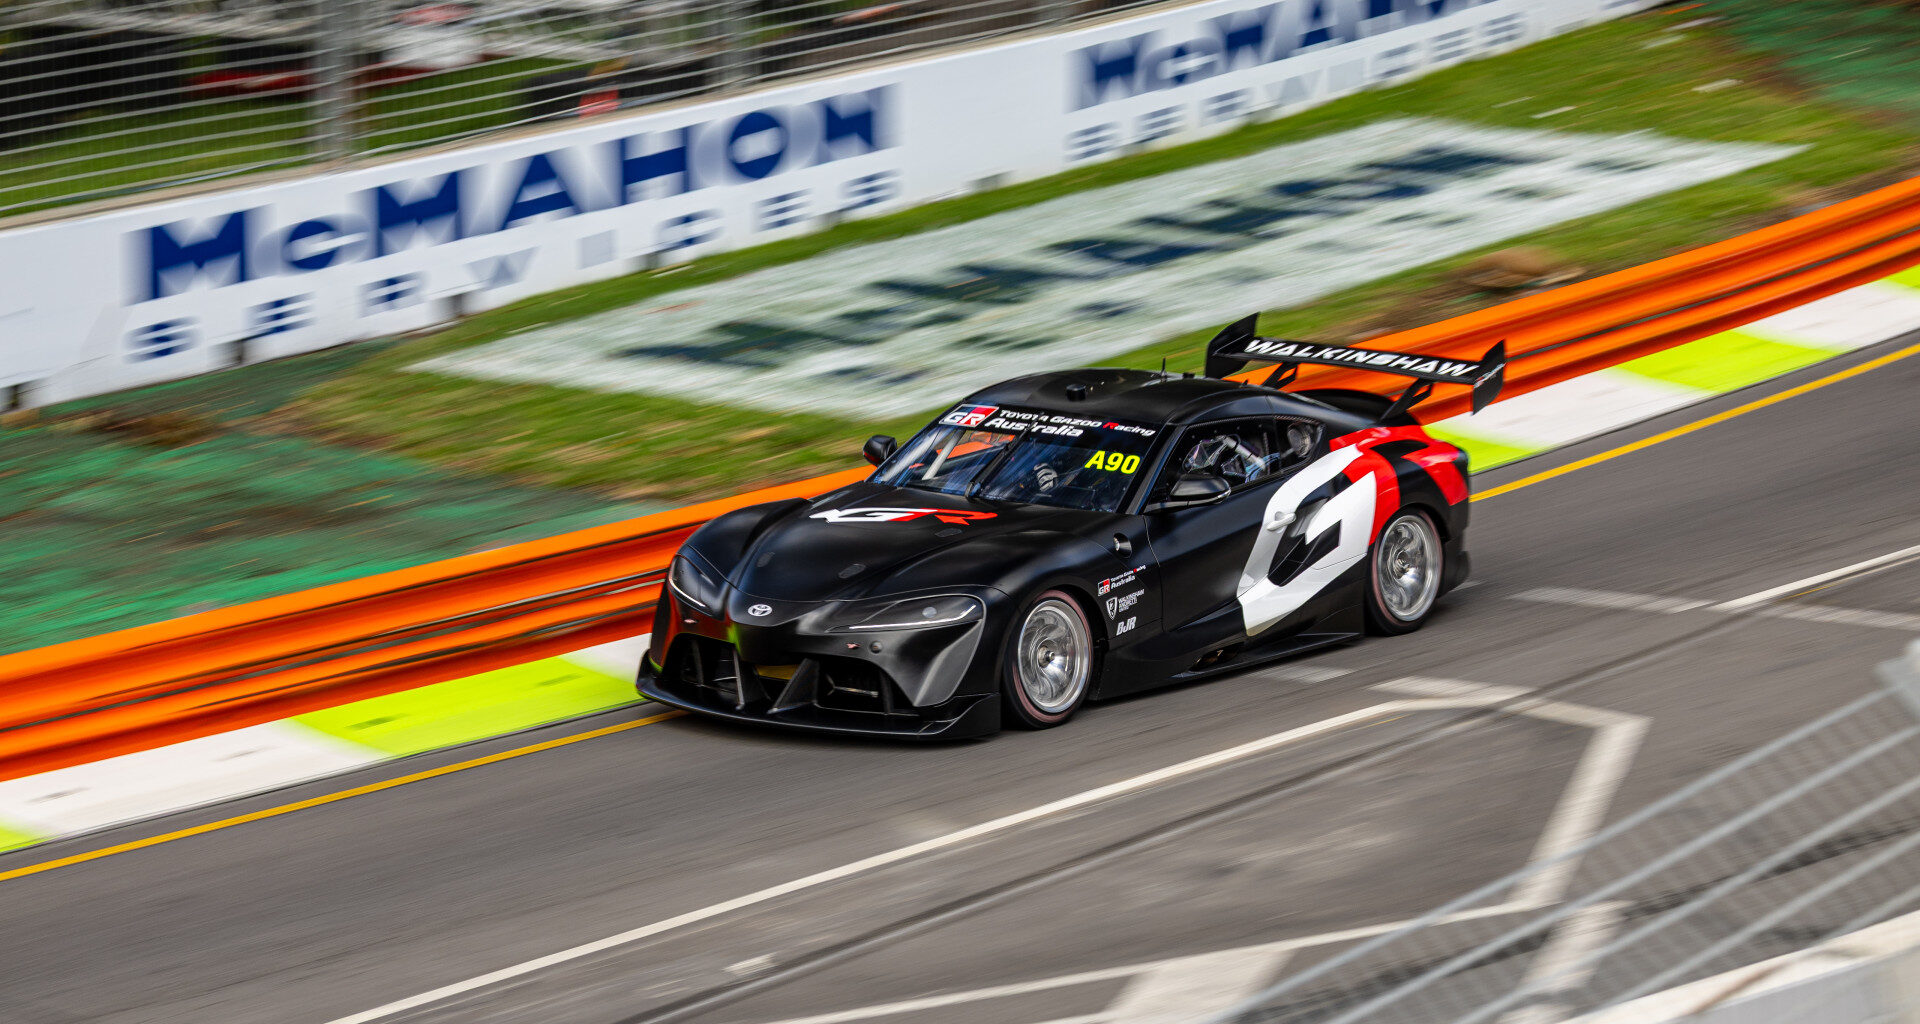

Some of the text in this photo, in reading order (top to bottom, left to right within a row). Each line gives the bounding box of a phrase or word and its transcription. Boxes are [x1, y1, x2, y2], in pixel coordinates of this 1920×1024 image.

[124, 84, 899, 306] McMAHON
[127, 170, 901, 362] SERVICES
[1244, 339, 1479, 377] WALKINSHAW
[943, 411, 986, 427] GR
[985, 418, 1084, 438] Australia
[1103, 422, 1157, 437] Racing
[1085, 450, 1141, 474] A90
